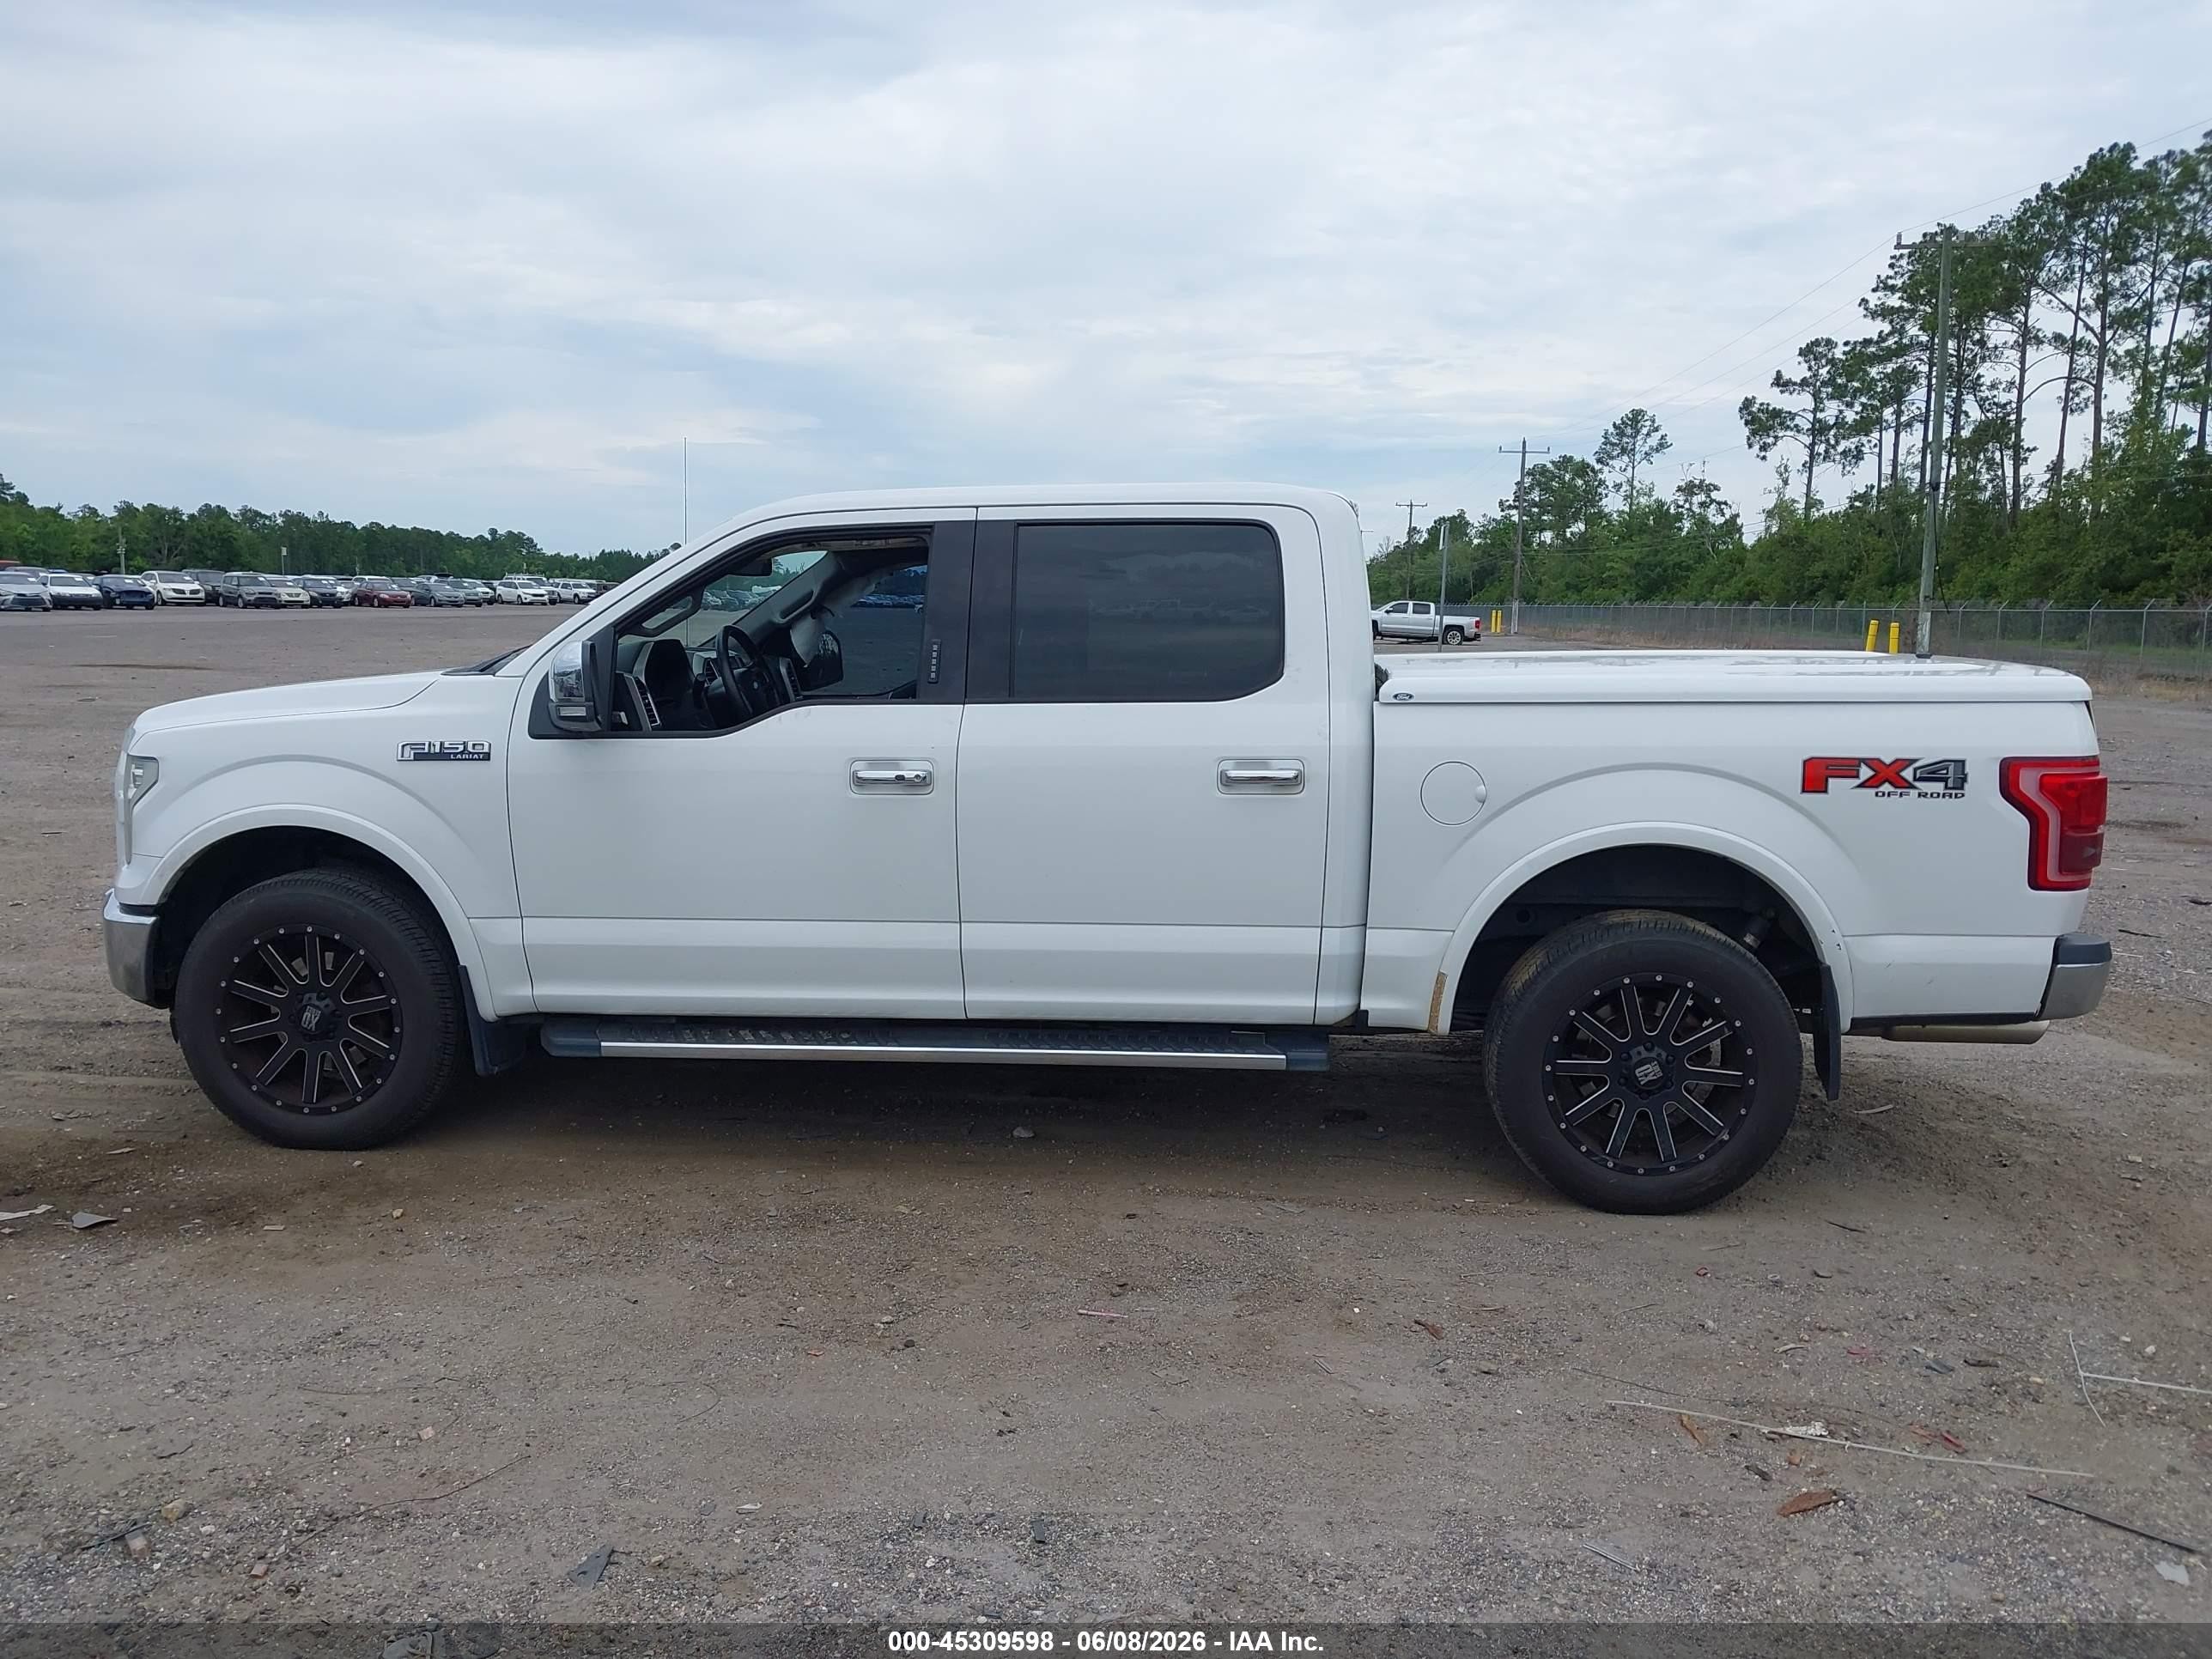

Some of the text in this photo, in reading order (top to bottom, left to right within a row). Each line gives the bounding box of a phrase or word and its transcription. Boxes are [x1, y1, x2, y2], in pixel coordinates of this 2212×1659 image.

[1801, 757, 1968, 794] FX4
[1875, 790, 1966, 799] OFF ROAD
